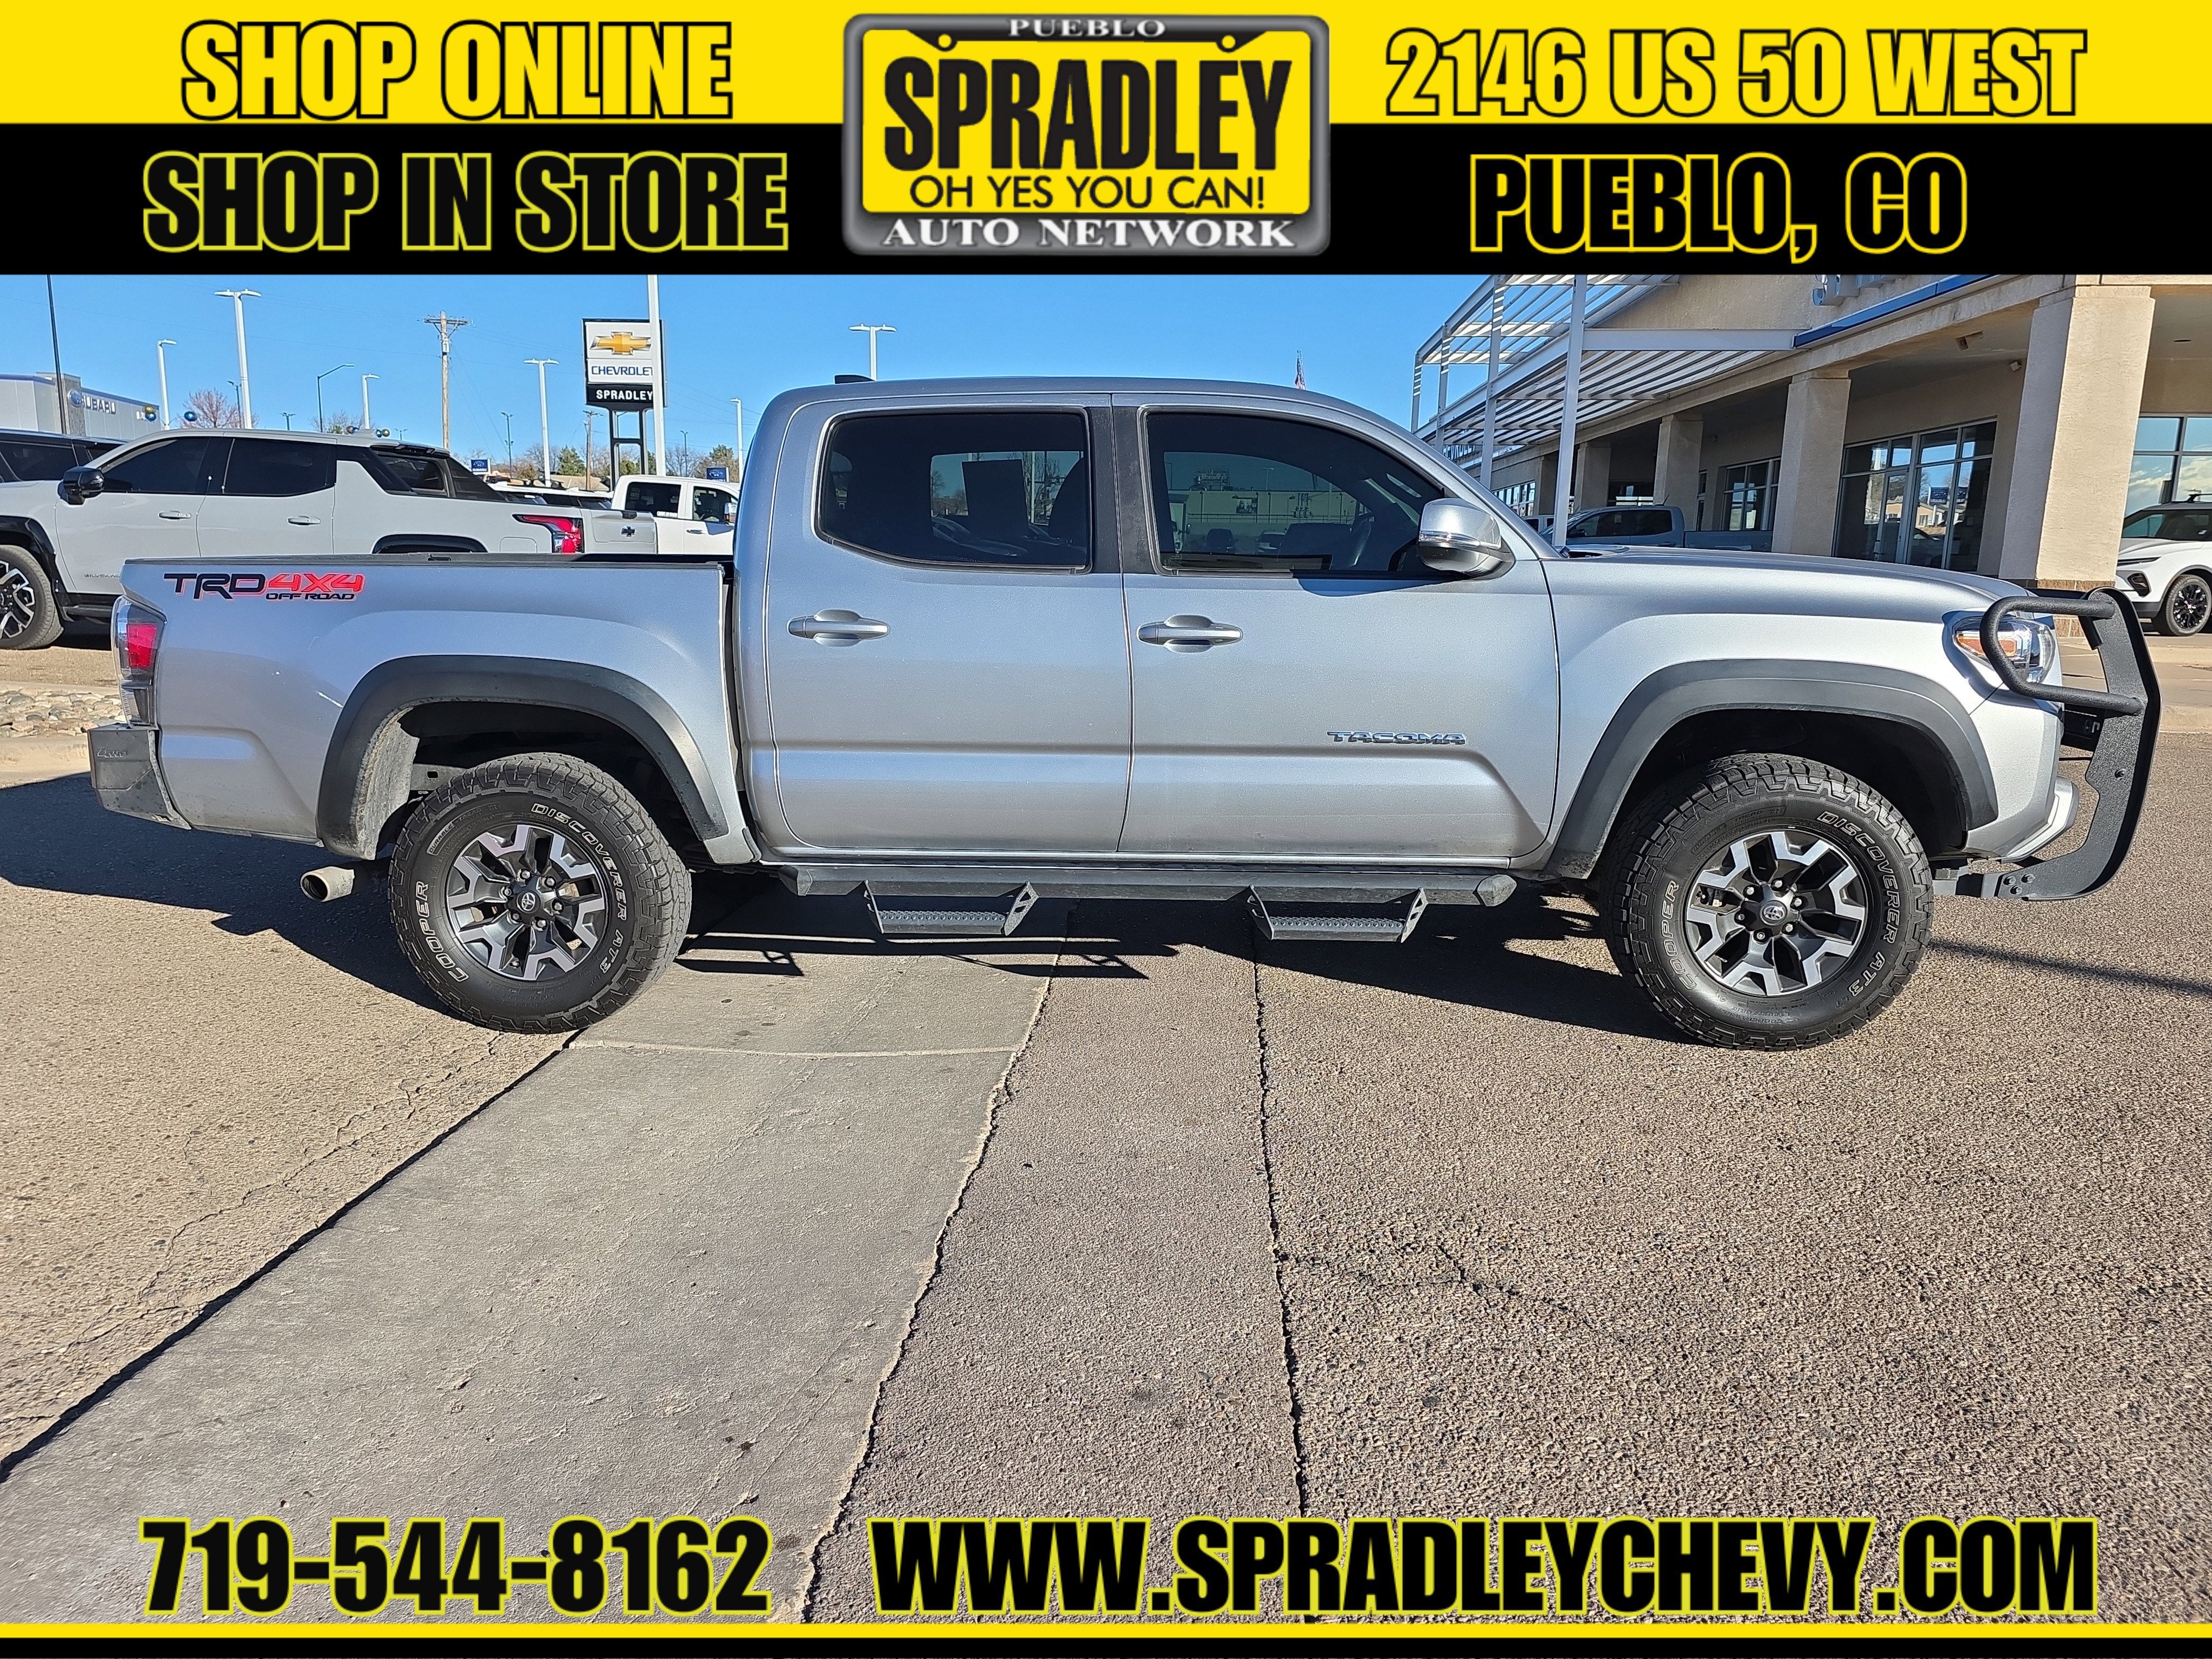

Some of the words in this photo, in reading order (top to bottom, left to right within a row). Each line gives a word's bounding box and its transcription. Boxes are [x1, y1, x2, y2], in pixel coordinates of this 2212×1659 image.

[596, 389, 653, 400] SPRADLEY
[163, 573, 266, 600] TRD
[268, 573, 364, 593] 4X4
[1326, 731, 1467, 745] TACOMA
[428, 822, 454, 854] DURABLE
[531, 803, 627, 921] DISCOVERER
[1816, 811, 1901, 944] DISCOVERER
[415, 880, 470, 982] COOPER
[599, 929, 624, 974] AT3
[1660, 880, 1697, 991] COOPER
[1848, 951, 1886, 997] AT3
